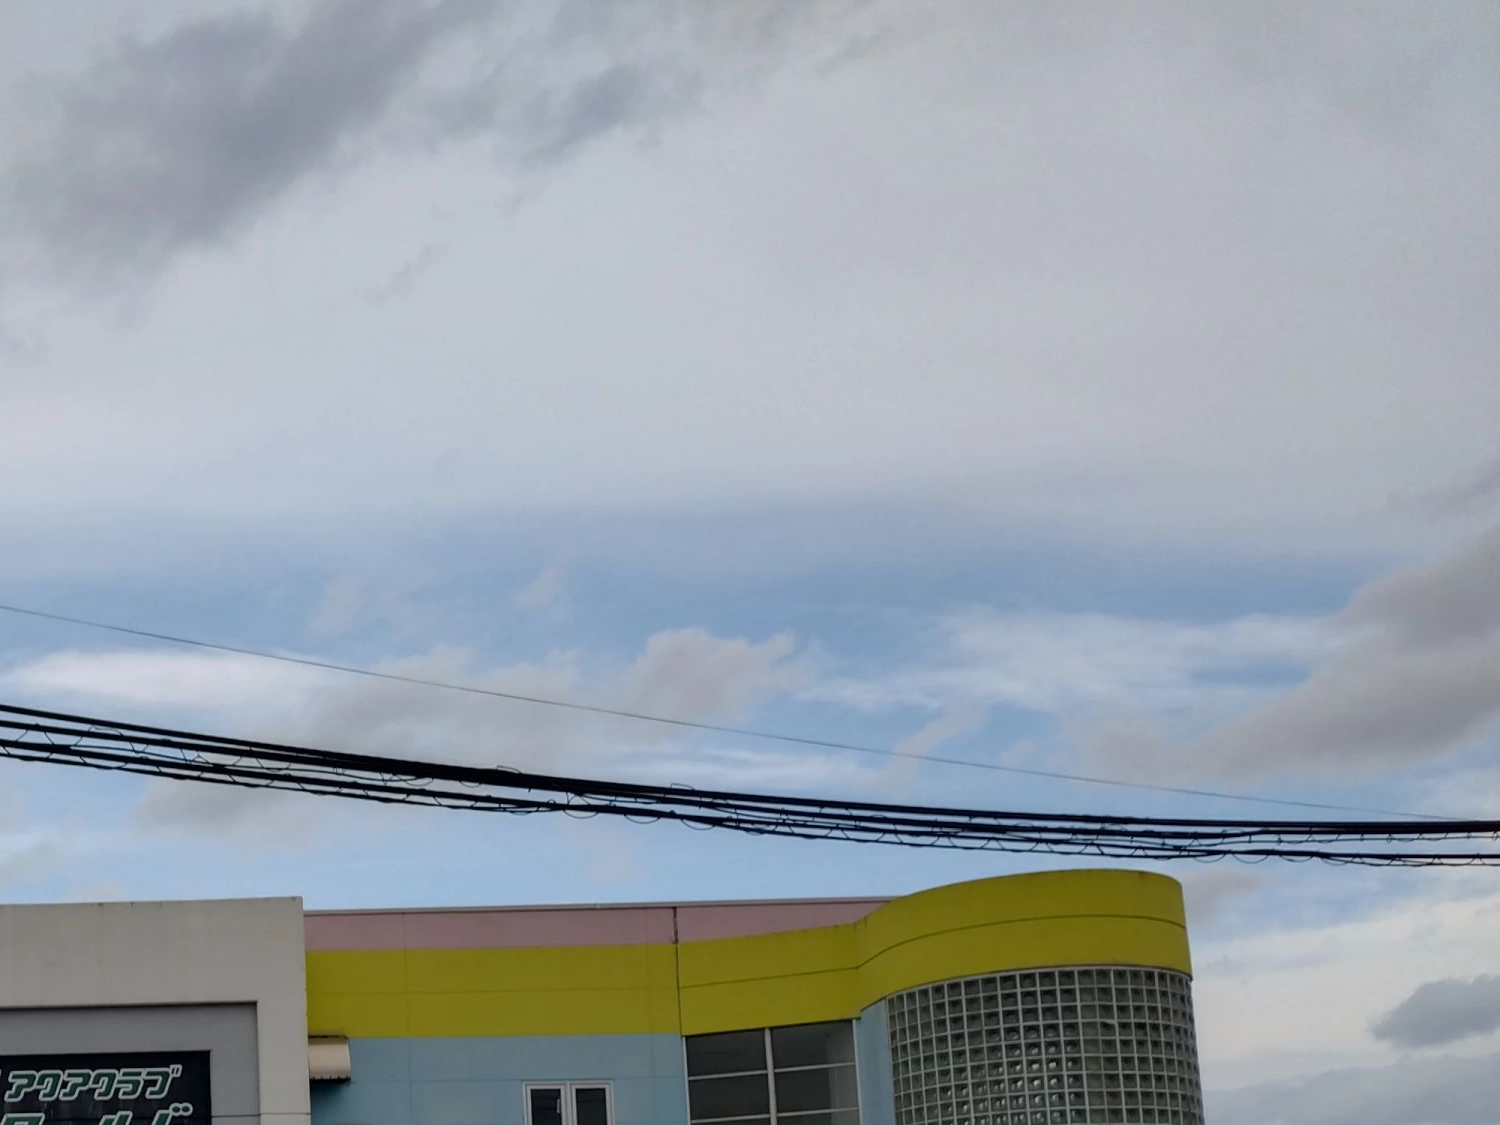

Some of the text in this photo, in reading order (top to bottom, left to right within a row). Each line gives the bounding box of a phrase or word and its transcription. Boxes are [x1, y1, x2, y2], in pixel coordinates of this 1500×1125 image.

[4, 1064, 182, 1102] アクアクラブ
